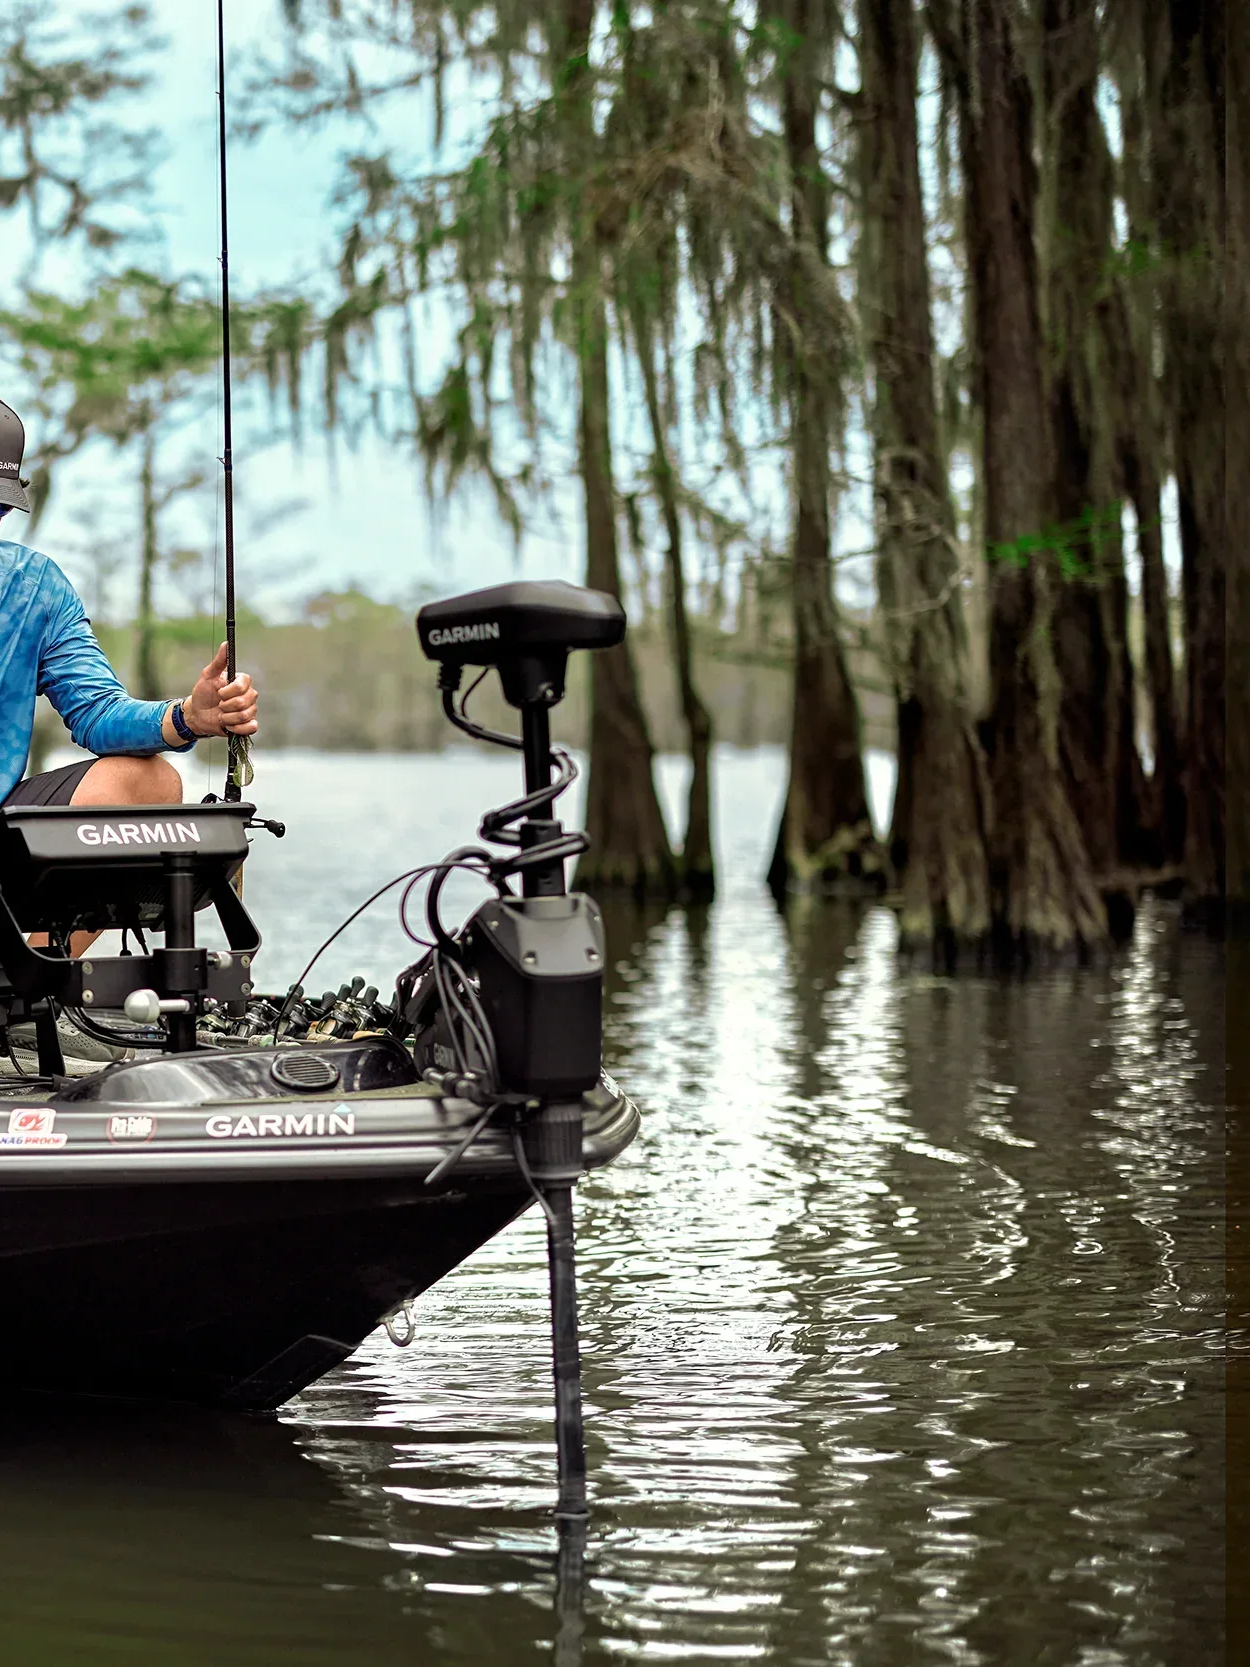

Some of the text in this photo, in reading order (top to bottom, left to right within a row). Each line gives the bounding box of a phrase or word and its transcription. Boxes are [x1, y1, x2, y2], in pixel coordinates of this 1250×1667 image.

[428, 622, 500, 645] GARMIN
[76, 822, 201, 845] GARMIN
[205, 1113, 356, 1138] GARMIN
[24, 1136, 63, 1145] PROOF
